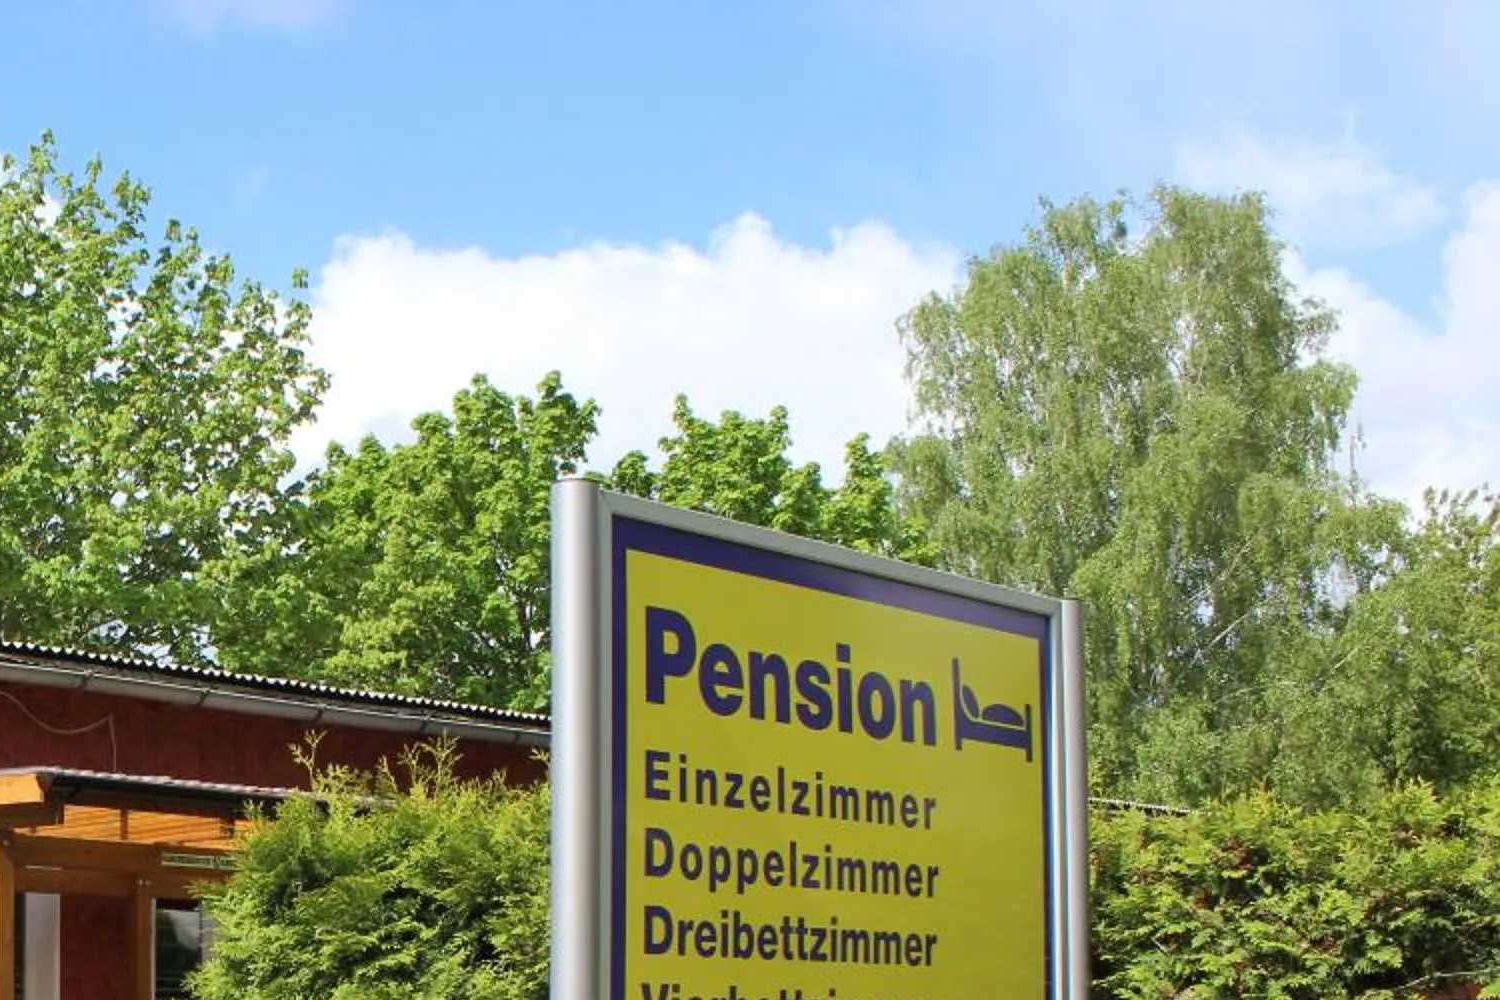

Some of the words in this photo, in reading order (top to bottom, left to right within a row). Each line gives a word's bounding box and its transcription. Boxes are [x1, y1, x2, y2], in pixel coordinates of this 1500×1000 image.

[646, 605, 936, 746] Pension
[646, 750, 935, 829] Einzelzimmer
[645, 828, 939, 898] Doppelzimmer
[643, 906, 937, 967] Dreibettzimmer
